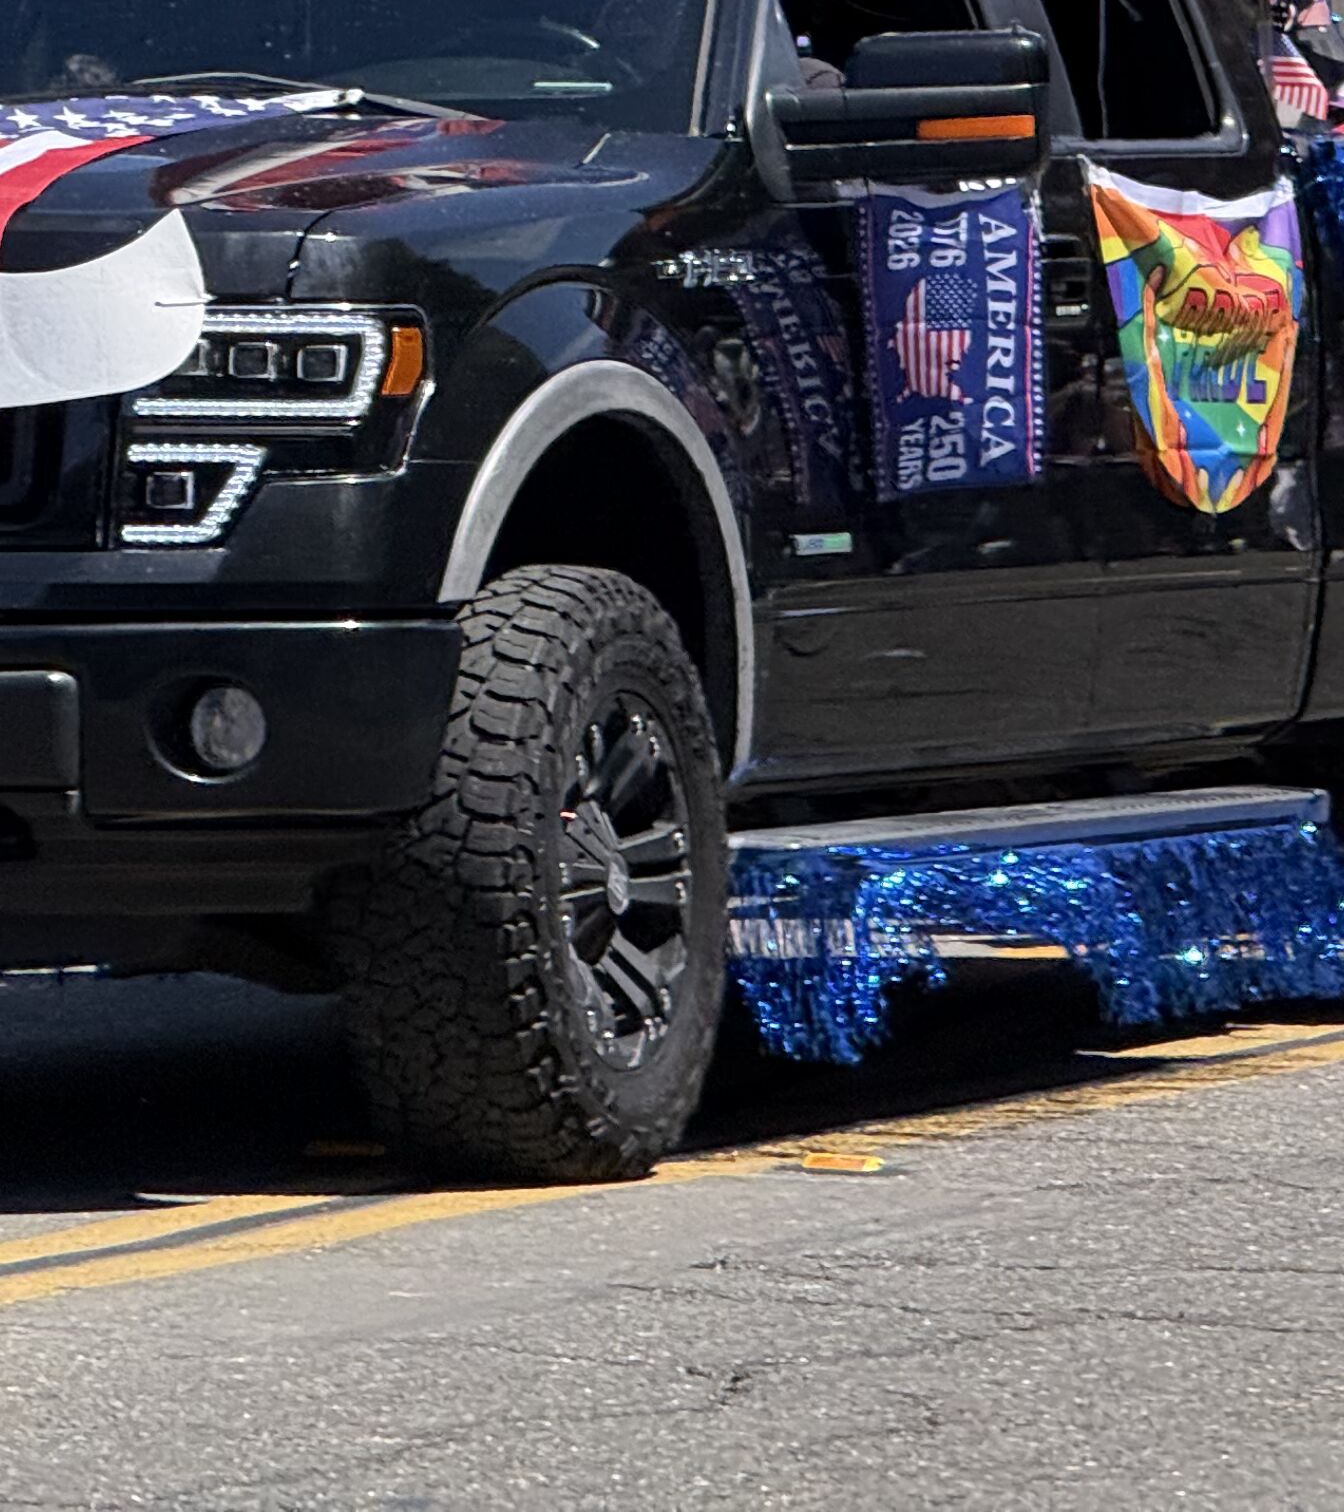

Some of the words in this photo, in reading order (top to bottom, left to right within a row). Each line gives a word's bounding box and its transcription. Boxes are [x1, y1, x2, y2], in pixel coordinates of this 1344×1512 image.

[886, 209, 924, 271] 2026
[978, 213, 1019, 467] AMERICA
[896, 417, 925, 489] YEARS
[925, 410, 968, 482] 250
